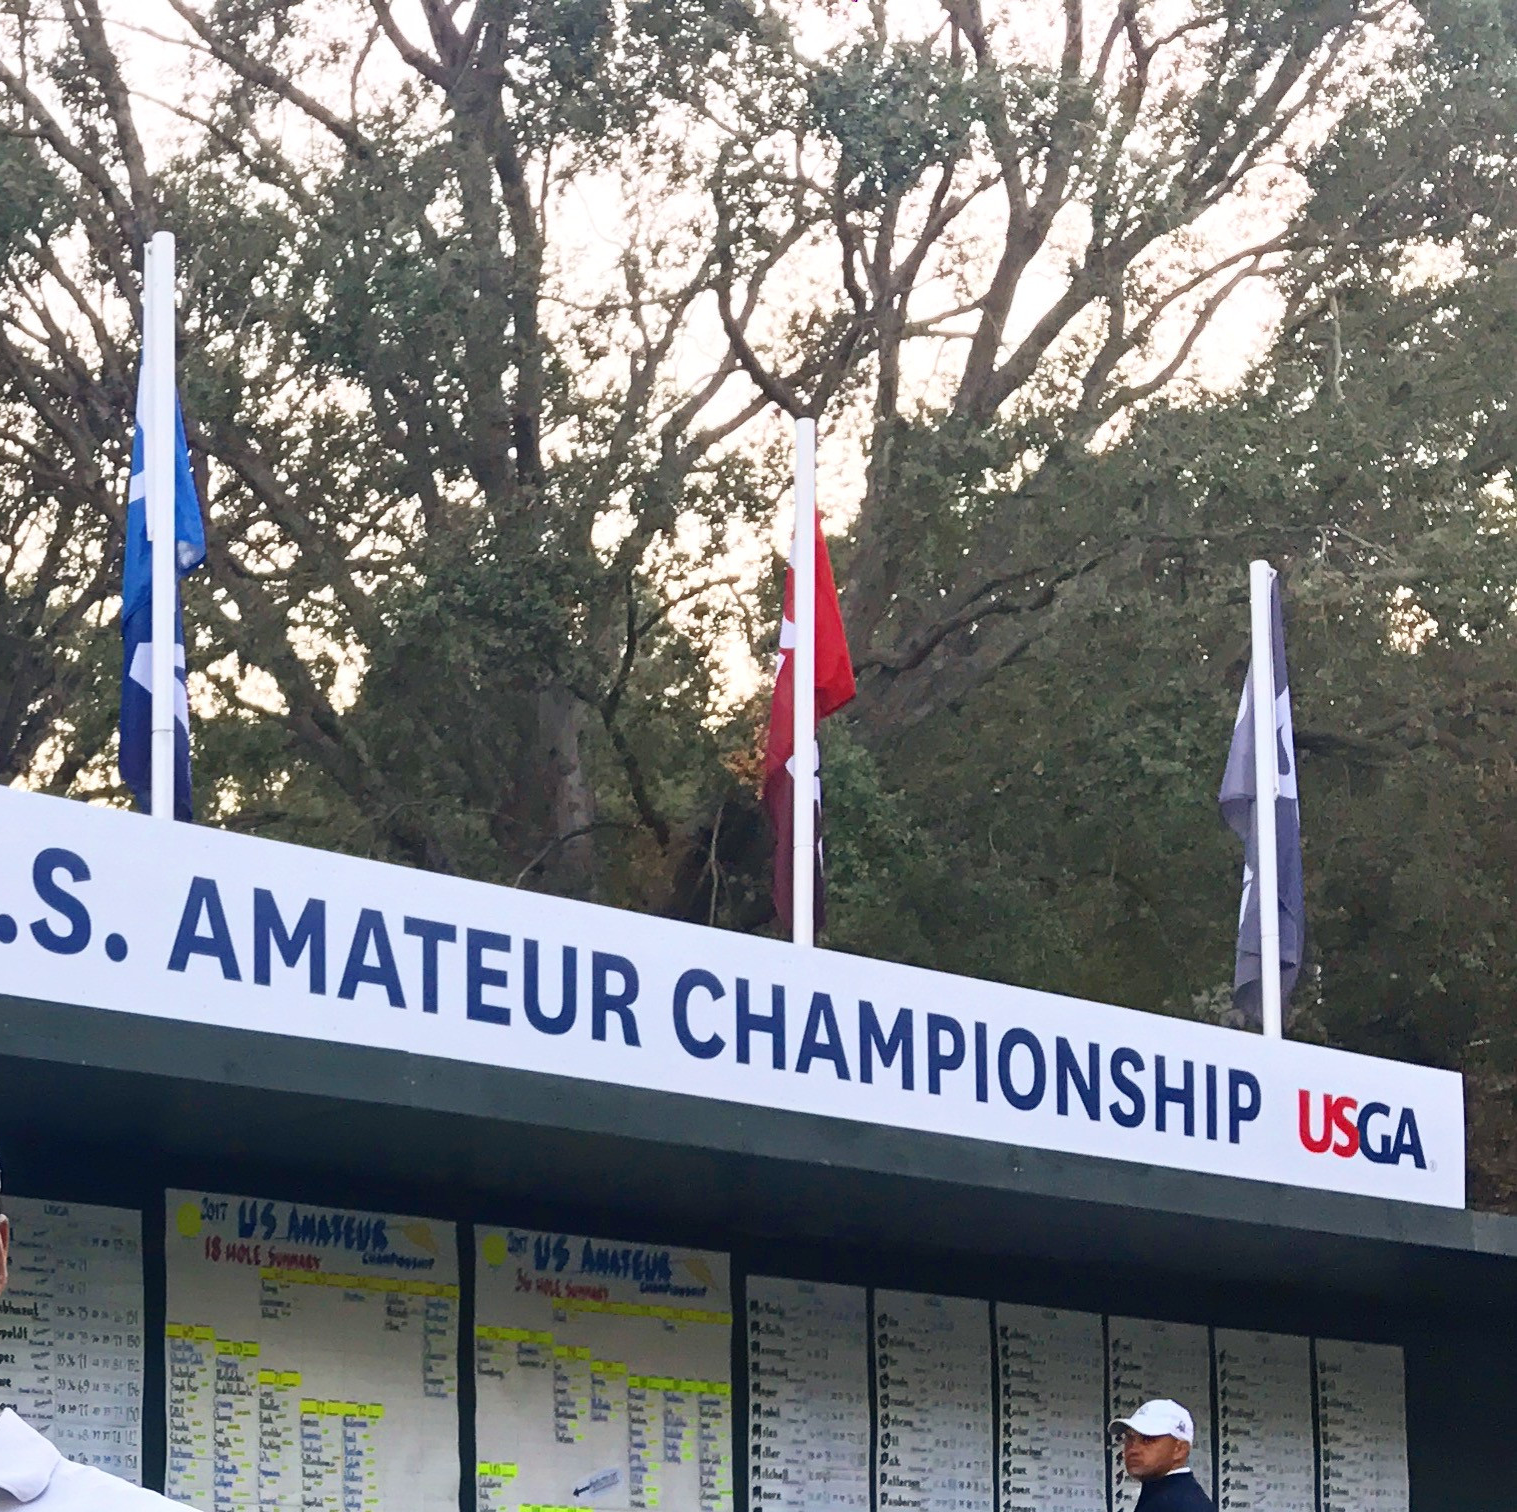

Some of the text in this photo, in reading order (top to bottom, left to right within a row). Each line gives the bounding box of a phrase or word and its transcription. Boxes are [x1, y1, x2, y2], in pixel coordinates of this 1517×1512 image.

[168, 877, 641, 1047] AMATEUR
[671, 969, 1261, 1145] CHAMPIONSHIP
[1297, 1088, 1427, 1170] USGA
[205, 1235, 221, 1261] 18
[226, 1244, 261, 1266] HOLE
[239, 1200, 277, 1240] US
[289, 1205, 388, 1251] AMATEUR
[534, 1233, 569, 1272] US
[582, 1238, 671, 1281] AMATEUR
